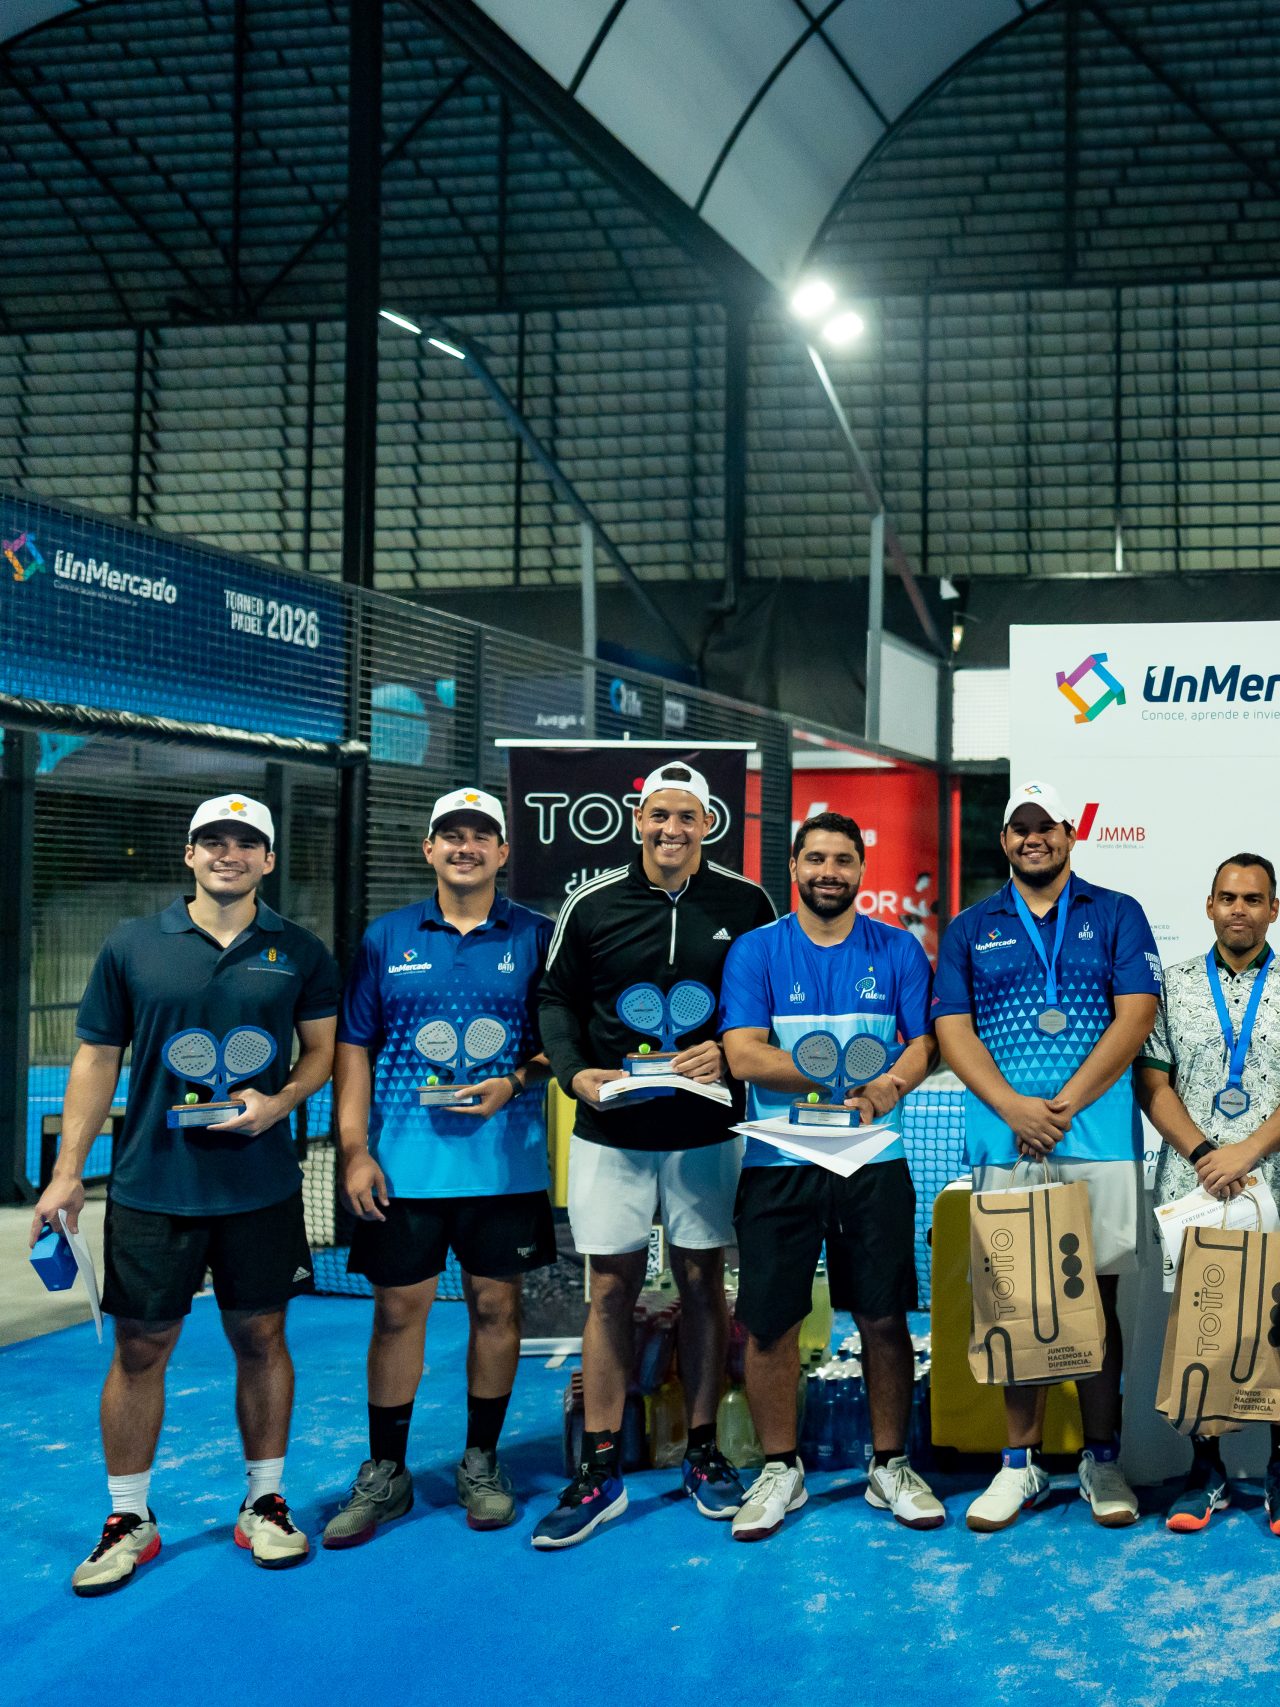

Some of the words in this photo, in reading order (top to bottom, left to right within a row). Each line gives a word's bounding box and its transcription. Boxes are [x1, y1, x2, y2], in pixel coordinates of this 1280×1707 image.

[54, 549, 178, 605] UnMercado
[224, 588, 265, 617] TORNEO
[231, 610, 265, 637] PADEL
[266, 600, 321, 649] 2026
[1141, 709, 1187, 722] Conoce,
[1190, 709, 1239, 722] aprende
[1243, 711, 1250, 720] e
[1096, 826, 1146, 841] JMMB
[975, 938, 1018, 951] UnMercado
[388, 962, 433, 975] UnMercado
[984, 1227, 1018, 1321] TOTTO
[1193, 1263, 1226, 1357] TOTTO
[1047, 1345, 1075, 1355] JUNTOS
[1048, 1352, 1082, 1362] HACEMOS
[1048, 1358, 1092, 1369] DIFERENCIA.
[1235, 1389, 1261, 1397] JUNTOS
[1234, 1396, 1267, 1405] HACEMOS
[1267, 1397, 1277, 1405] LA
[1233, 1404, 1274, 1412] DIFERENCIA.
